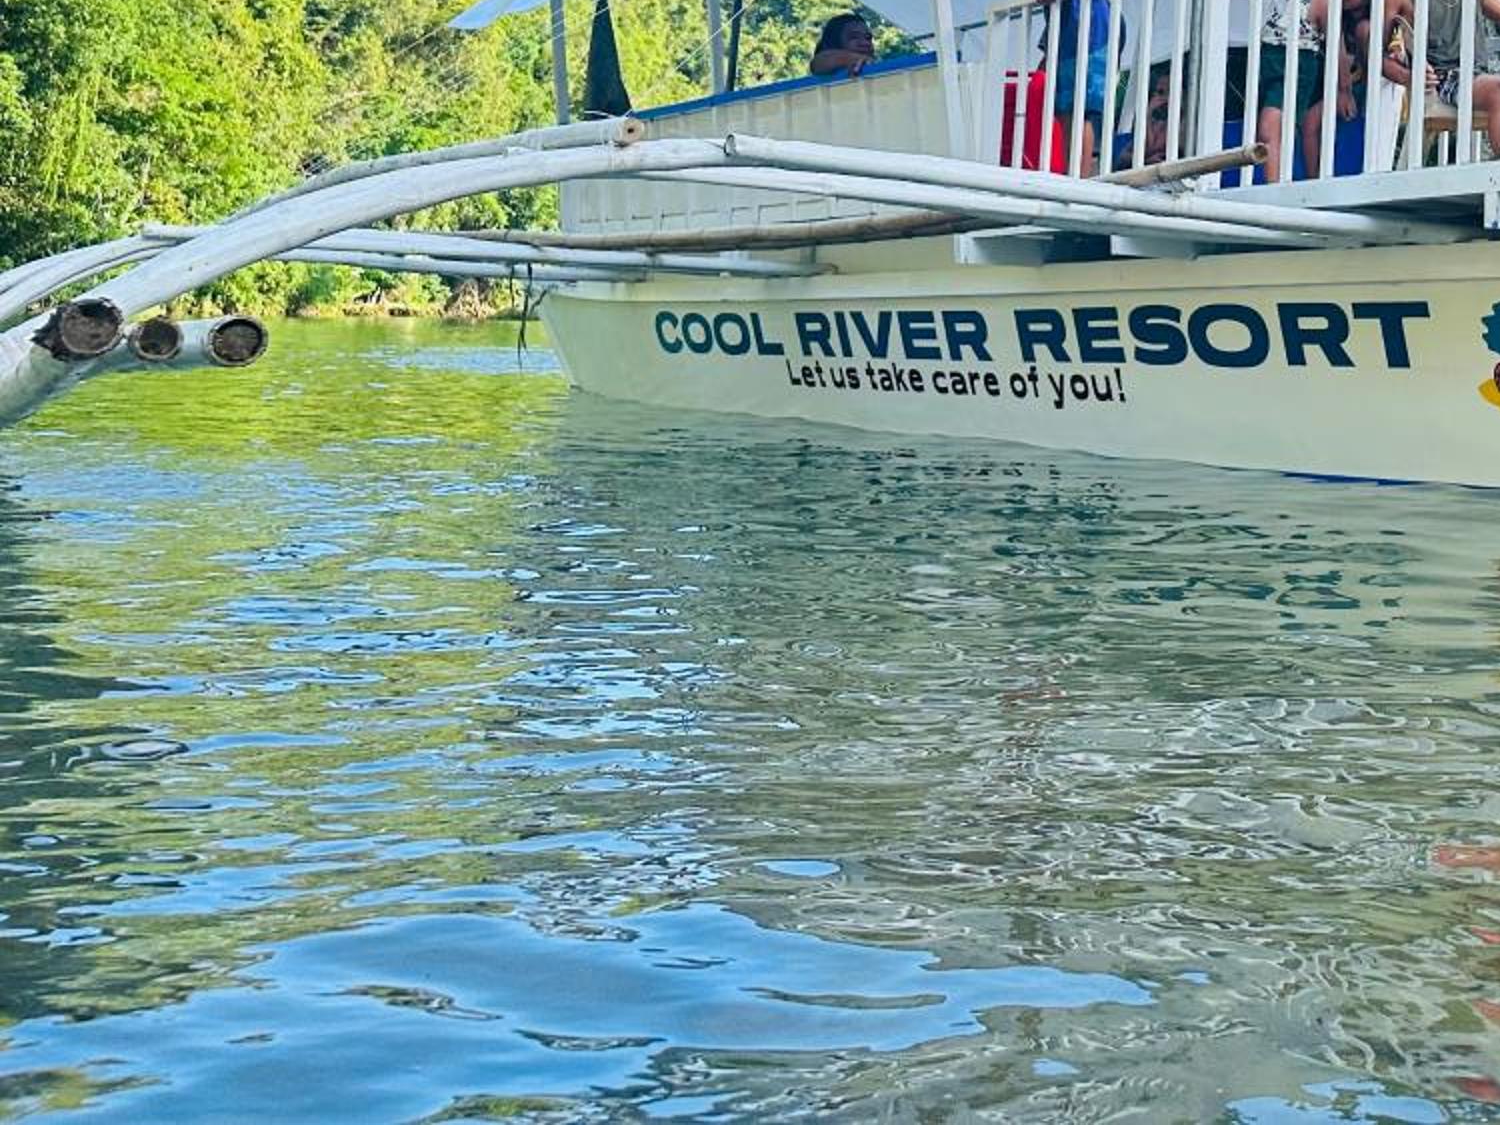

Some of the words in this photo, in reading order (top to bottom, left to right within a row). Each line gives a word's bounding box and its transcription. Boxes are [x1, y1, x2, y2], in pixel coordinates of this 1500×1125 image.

[655, 310, 785, 356] COOL
[793, 310, 993, 362] RIVER
[1013, 300, 1431, 370] RESORT
[786, 358, 827, 388] Let
[829, 366, 861, 390] us
[864, 361, 925, 393] take
[931, 370, 1001, 397] care
[1009, 365, 1040, 399] of
[1047, 367, 1127, 410] you!
